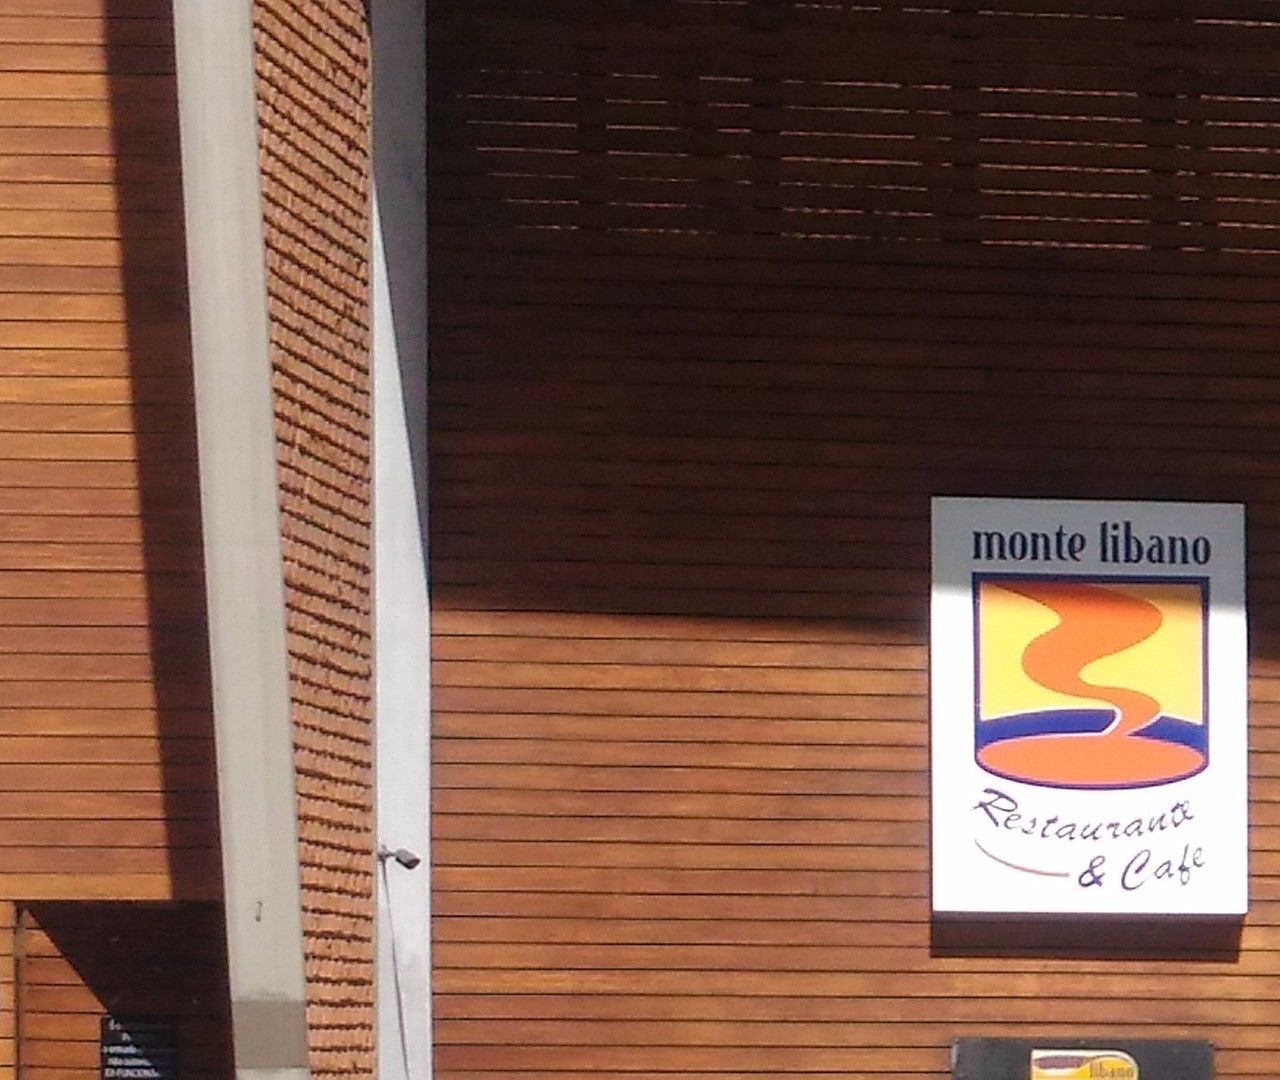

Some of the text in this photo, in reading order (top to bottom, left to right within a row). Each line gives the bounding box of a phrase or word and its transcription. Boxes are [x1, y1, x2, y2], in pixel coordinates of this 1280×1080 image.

[972, 520, 1212, 565] monte libano
[971, 788, 1194, 840] Restaurante
[1078, 855, 1106, 887] &
